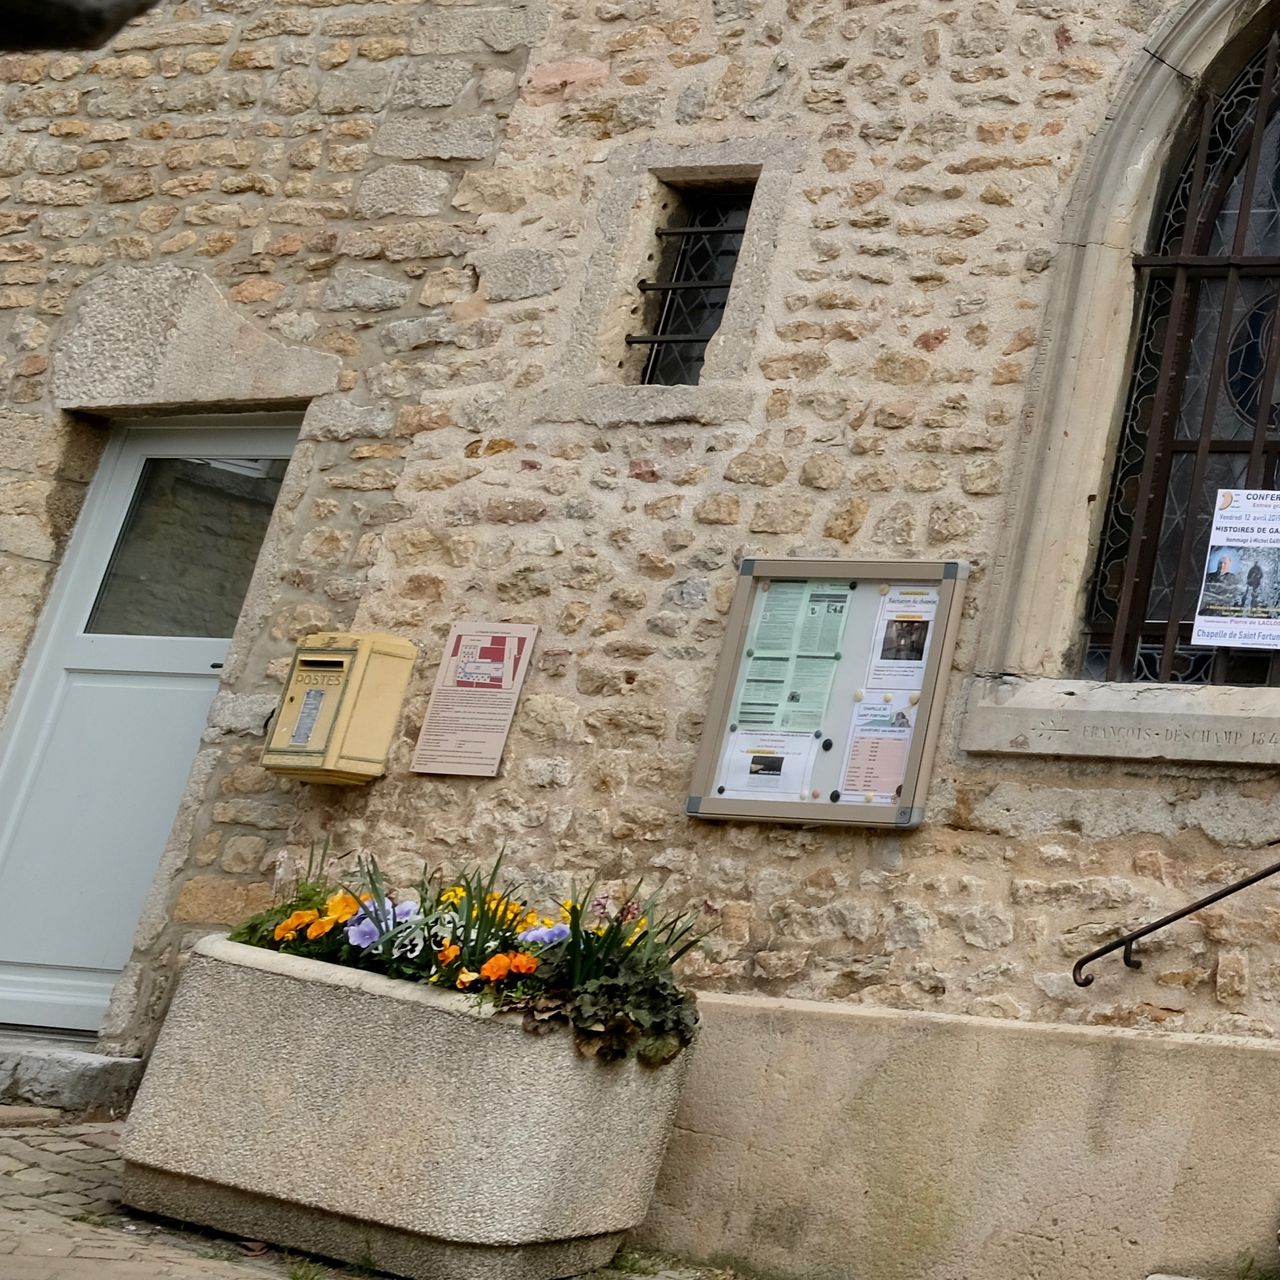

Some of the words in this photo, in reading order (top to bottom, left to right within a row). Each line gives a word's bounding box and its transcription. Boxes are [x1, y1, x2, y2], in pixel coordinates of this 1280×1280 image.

[1268, 514, 1280, 522] 2019
[1197, 629, 1227, 639] Chapelle
[1228, 631, 1237, 639] de
[1238, 631, 1256, 640] Saint
[295, 674, 342, 686] POSTES
